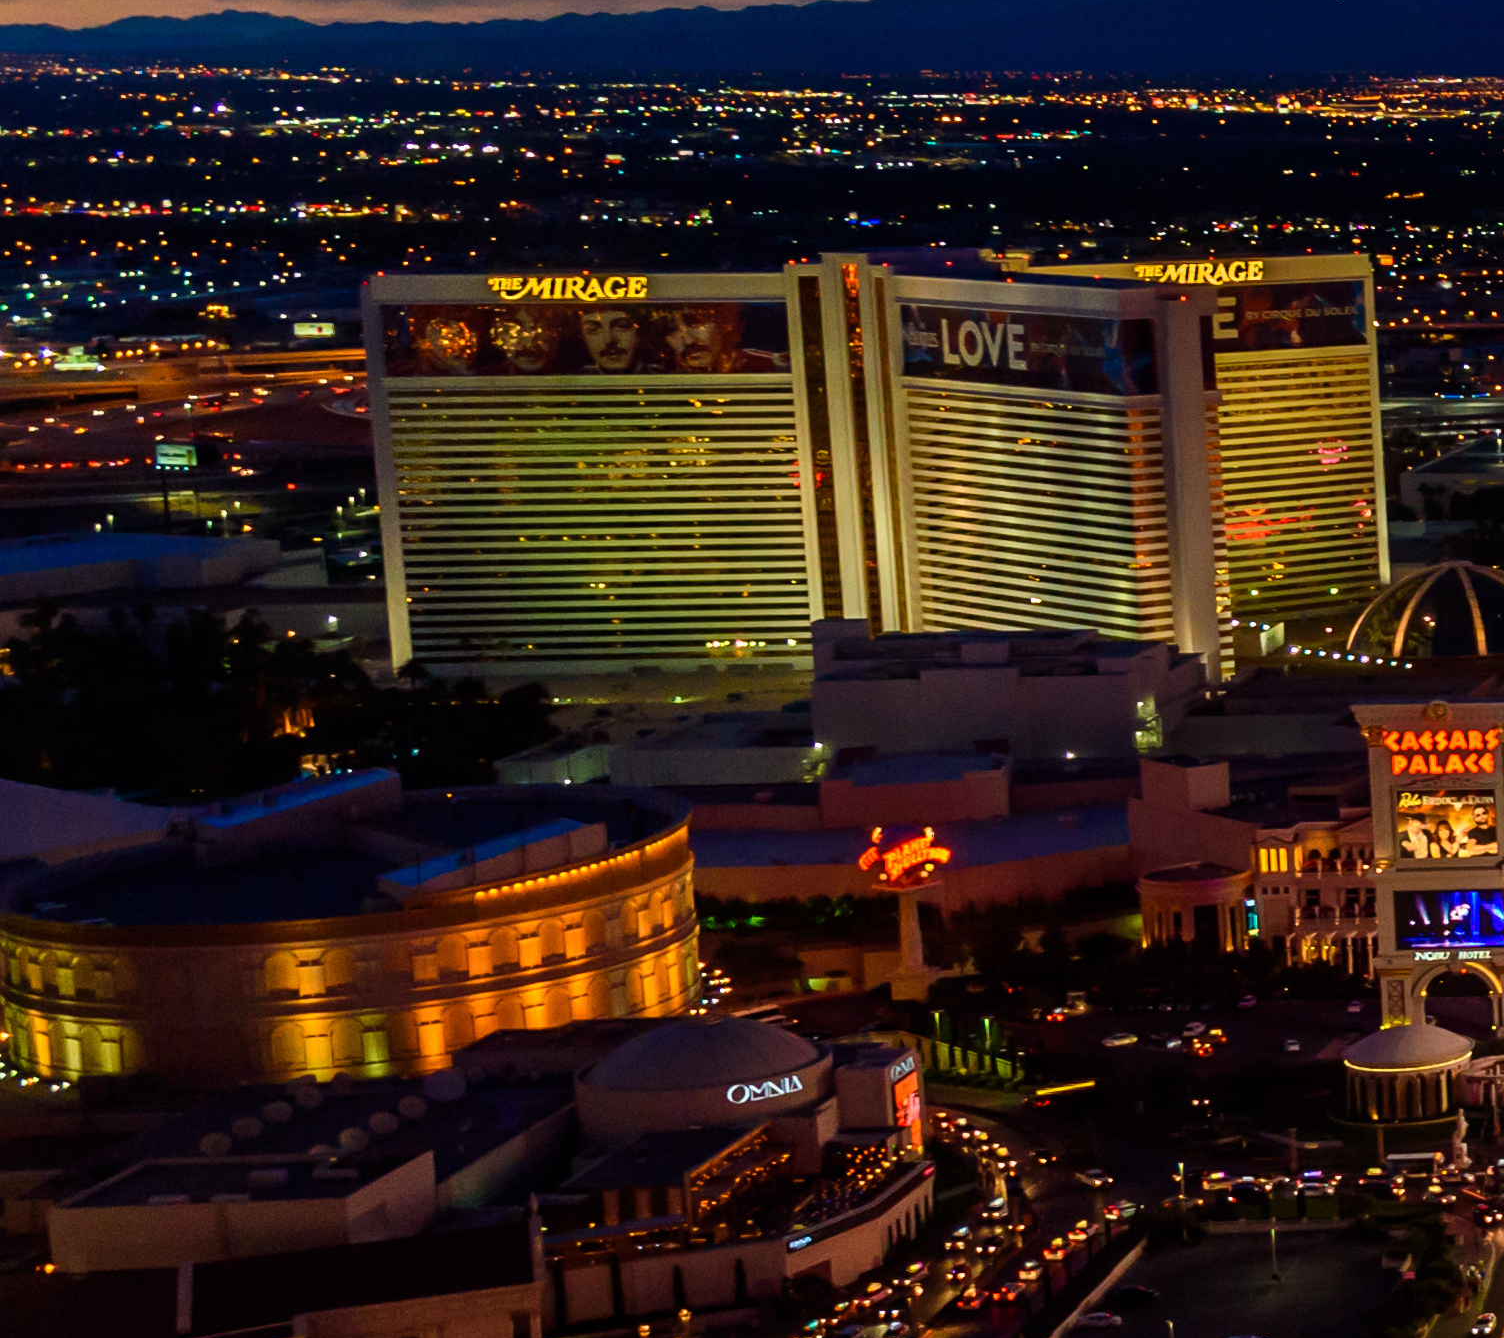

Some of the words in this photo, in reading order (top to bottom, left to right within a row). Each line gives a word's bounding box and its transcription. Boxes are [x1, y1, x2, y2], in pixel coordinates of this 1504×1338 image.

[1134, 264, 1163, 278] THE
[1147, 261, 1263, 285] MIRAGE
[487, 276, 523, 291] THE
[500, 276, 648, 302] MIRAGE
[941, 318, 1028, 371] LOVE
[1382, 728, 1500, 752] CAESARS
[1391, 752, 1495, 775] PALACE
[1414, 951, 1450, 961] NOBU
[1458, 951, 1492, 960] HOTEL
[727, 1075, 803, 1104] OMNIA
